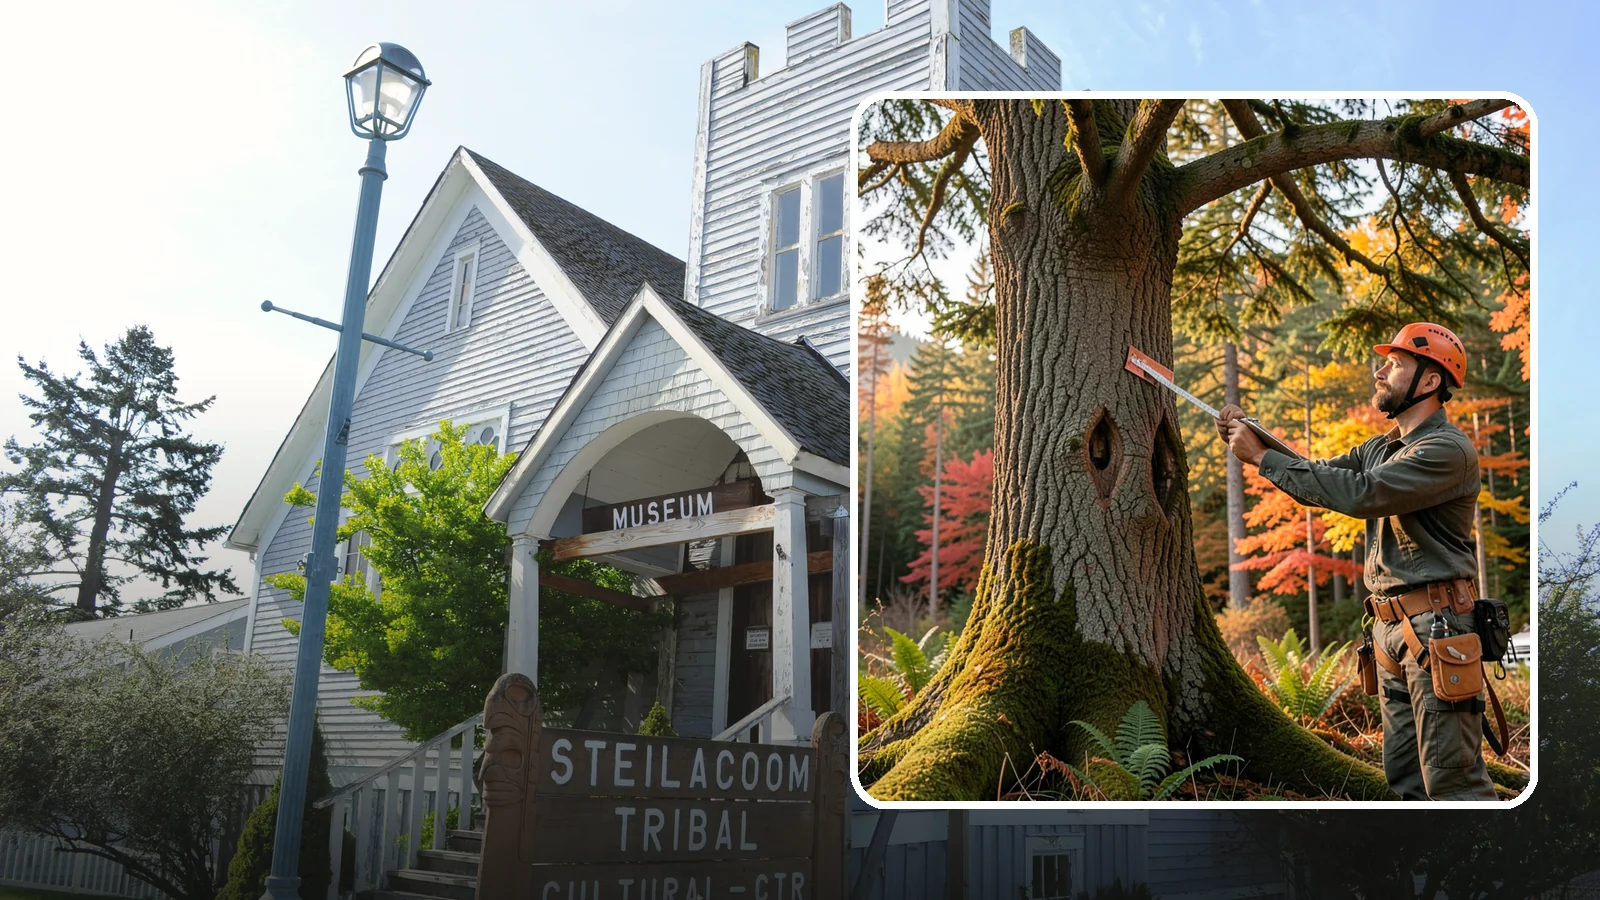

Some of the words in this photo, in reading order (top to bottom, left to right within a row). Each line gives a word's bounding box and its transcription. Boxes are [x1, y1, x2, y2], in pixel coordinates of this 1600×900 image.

[613, 491, 713, 530] MUSEUM
[550, 738, 809, 792] STEILACOOM
[615, 807, 757, 851] TRIBAL
